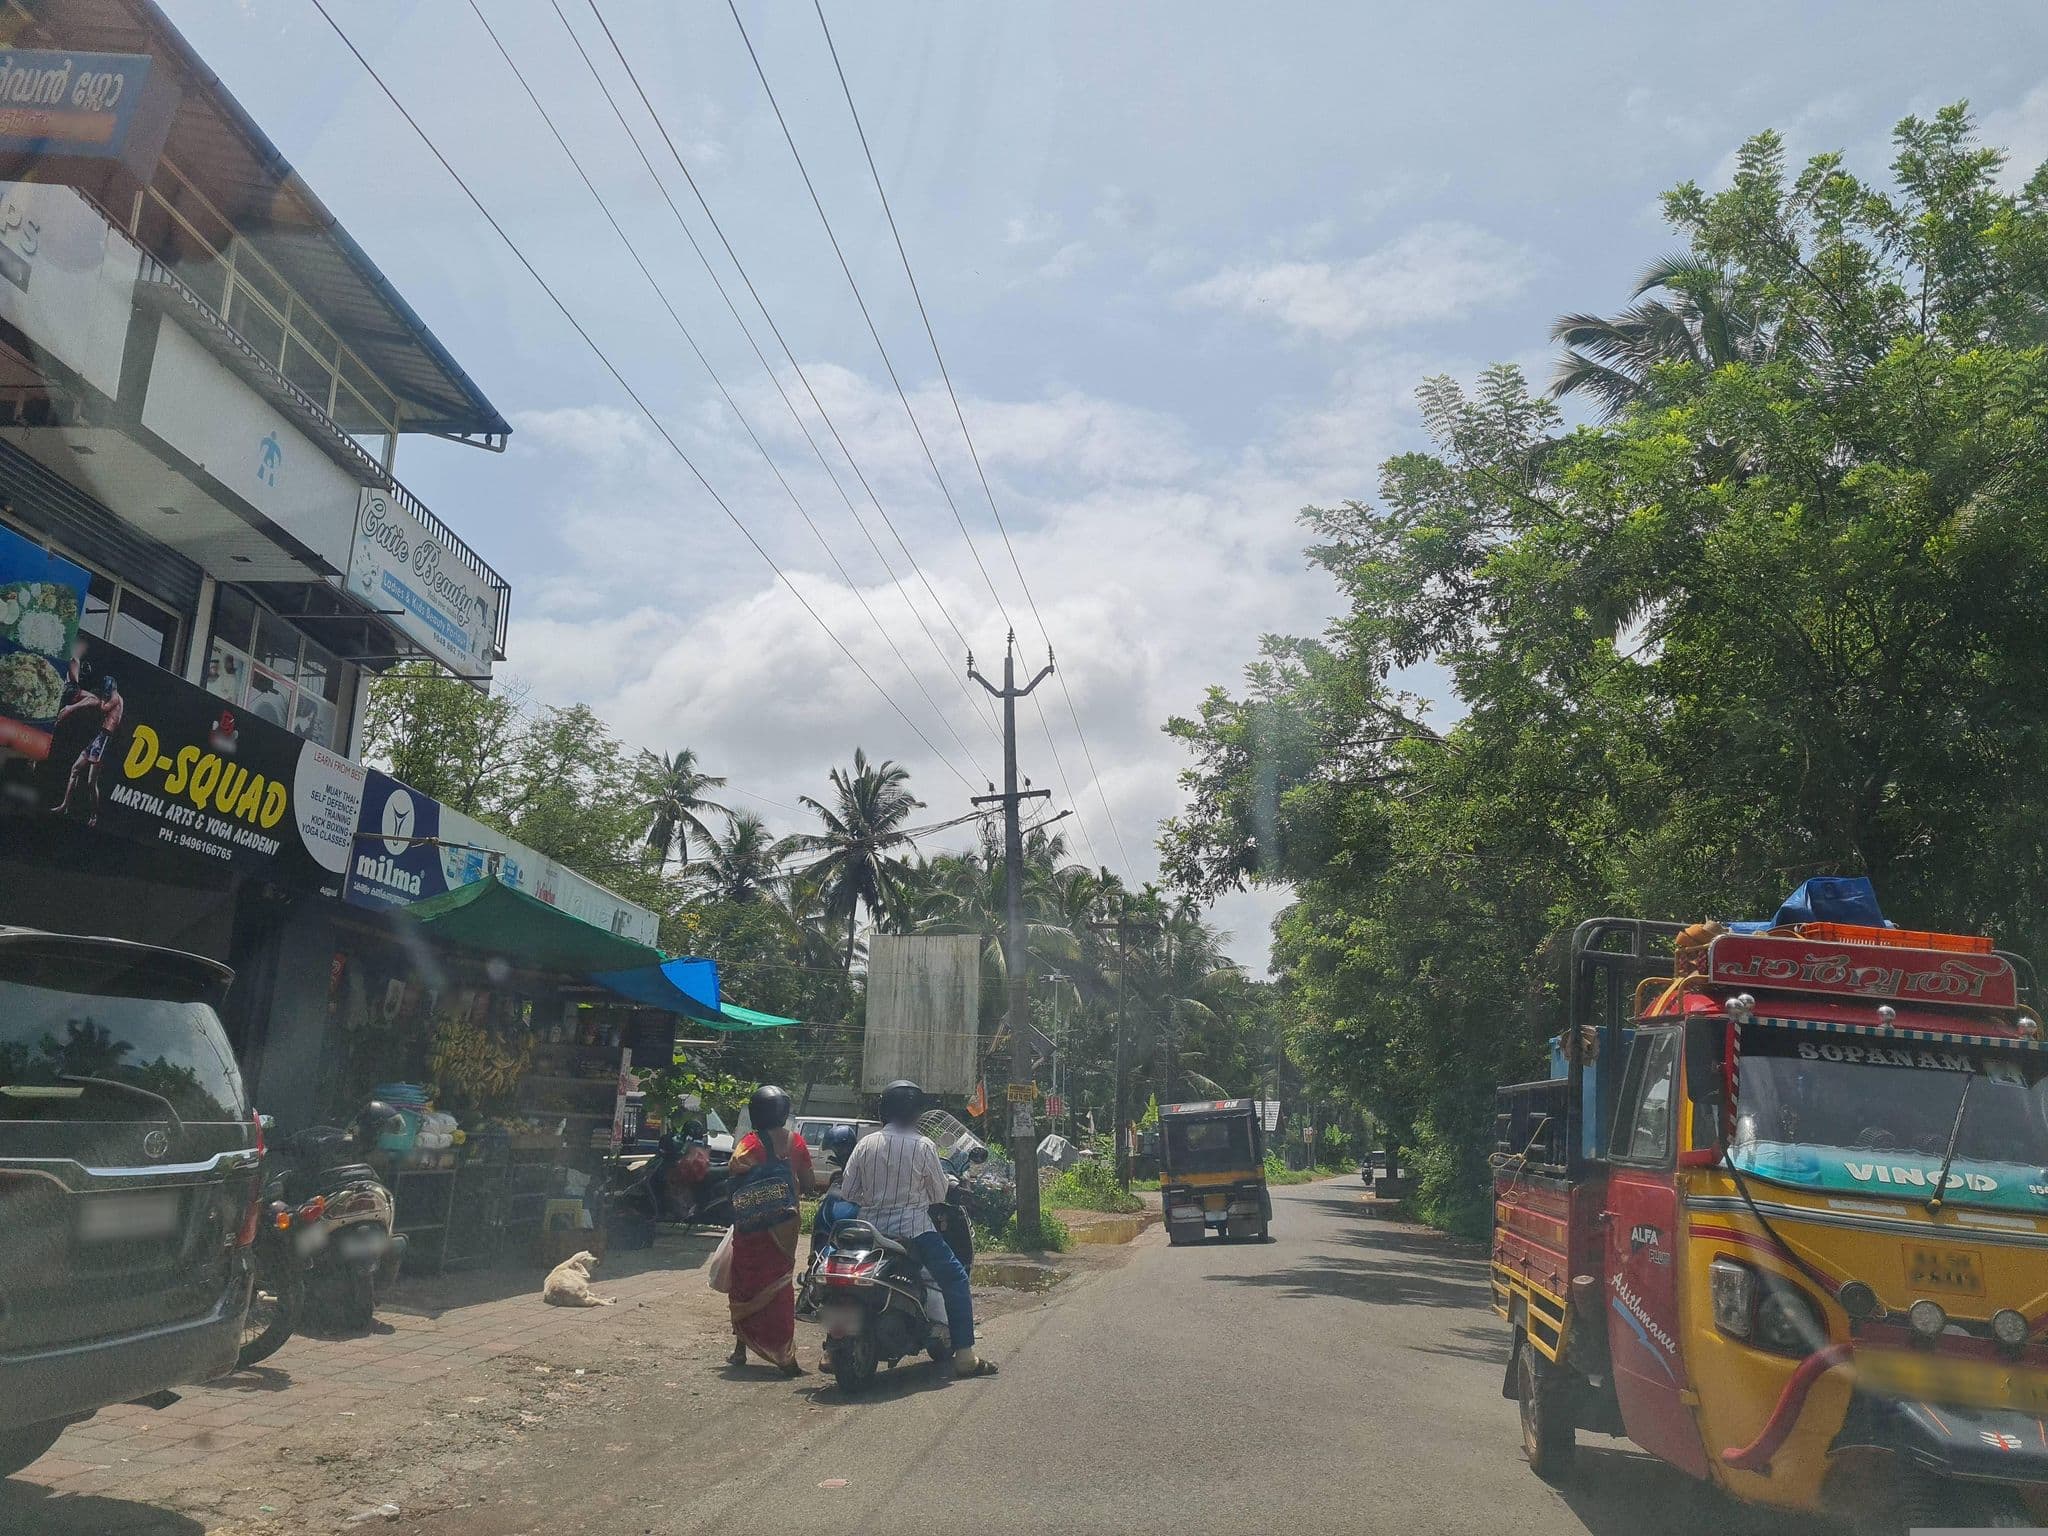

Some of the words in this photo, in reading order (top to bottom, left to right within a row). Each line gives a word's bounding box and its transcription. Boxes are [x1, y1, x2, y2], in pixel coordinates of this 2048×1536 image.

[361, 488, 409, 562] Cutie
[412, 540, 474, 627] Beauty
[123, 724, 287, 829] D-SQUAD
[314, 751, 333, 769] LEARN
[333, 761, 351, 775] FROM
[310, 790, 327, 803] SELF
[326, 797, 353, 815] DEFENCE
[326, 784, 342, 798] MUAY
[342, 791, 356, 804] THAI
[110, 784, 163, 817] MARTIAL
[165, 803, 196, 827] ARTS
[195, 814, 205, 830] &
[205, 817, 233, 841] YOGA
[233, 828, 281, 856] ACADEMY
[311, 814, 326, 828] KICK
[326, 820, 349, 837] BOXING
[325, 807, 351, 826] TRAINING
[158, 827, 174, 842] PH
[179, 834, 232, 861] 9496166765
[302, 822, 319, 838] YOGA
[319, 831, 346, 848] CLASSES
[356, 855, 421, 896] milma
[1799, 1042, 1977, 1073] SOPANAM
[1844, 1162, 1998, 1192] VINOD
[1631, 1227, 1659, 1246] ALFA
